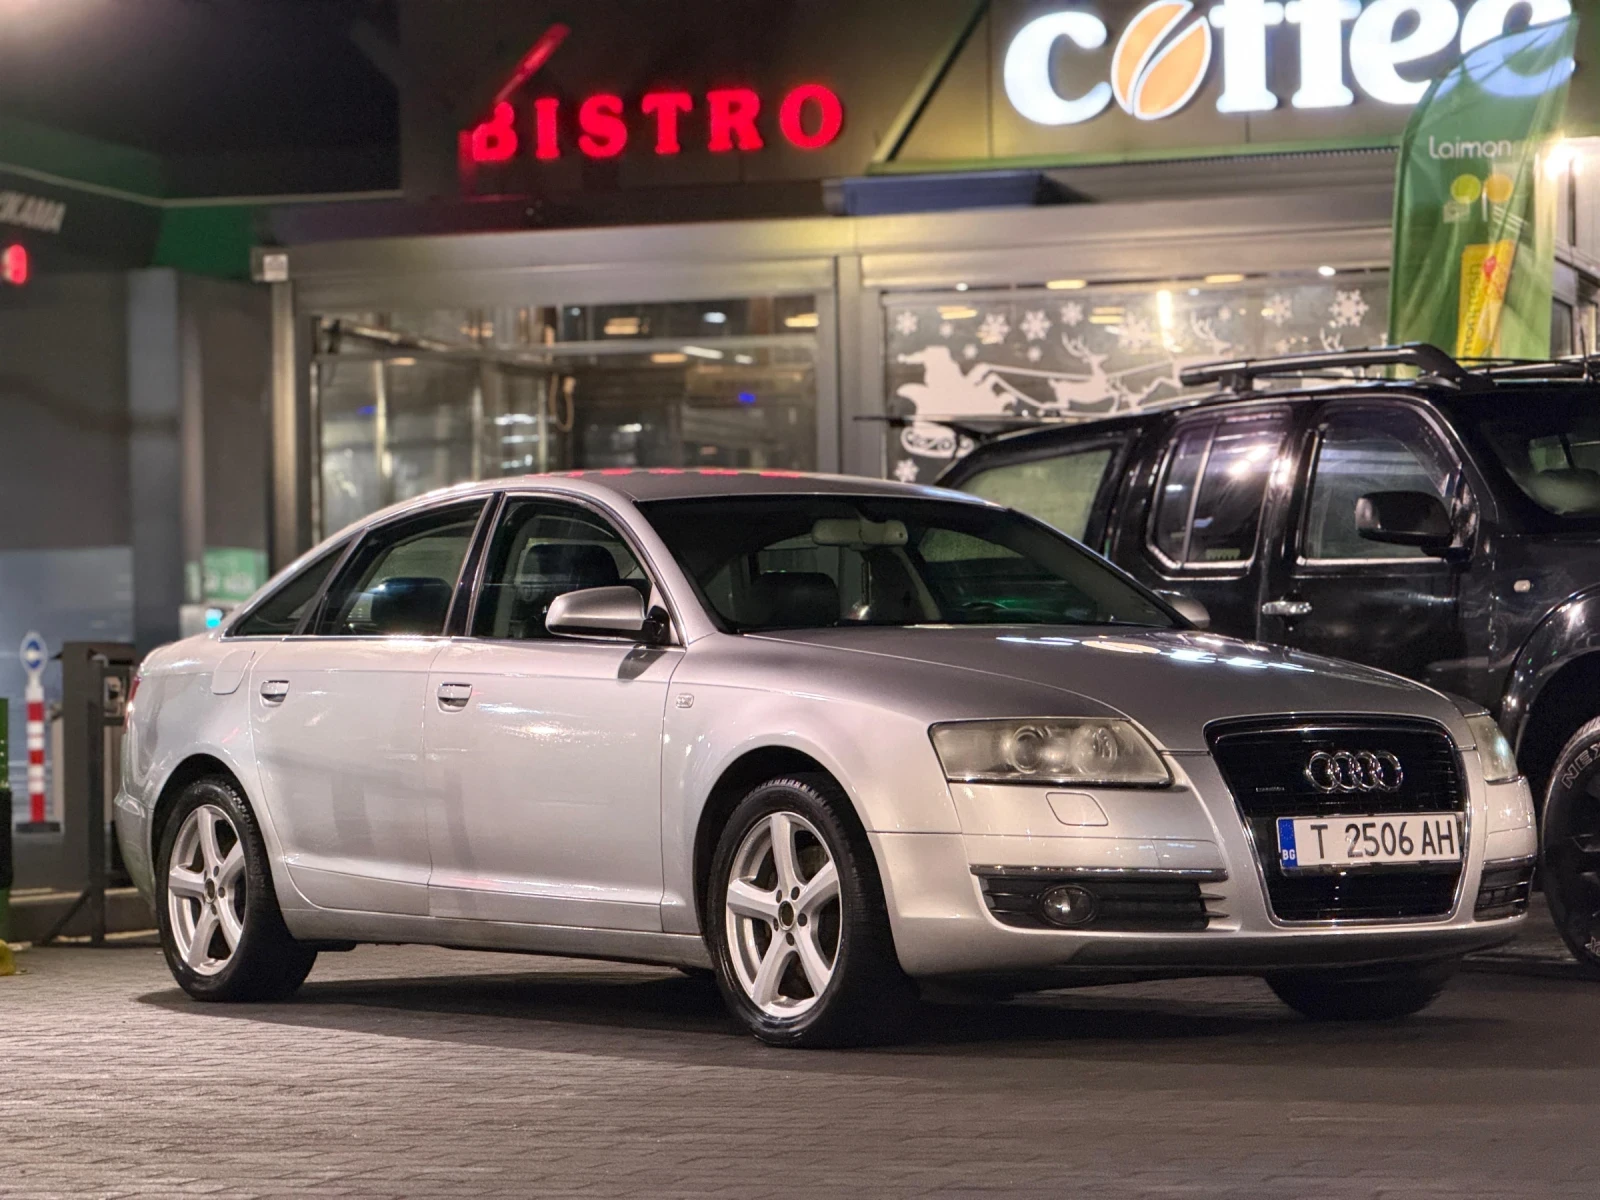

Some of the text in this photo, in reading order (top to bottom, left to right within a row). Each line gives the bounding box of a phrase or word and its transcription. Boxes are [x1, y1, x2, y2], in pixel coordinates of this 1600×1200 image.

[1003, 0, 1576, 126] coffee
[471, 83, 843, 162] BISTRO
[1282, 849, 1297, 861] BG
[1309, 820, 1455, 860] T 2506 AH
